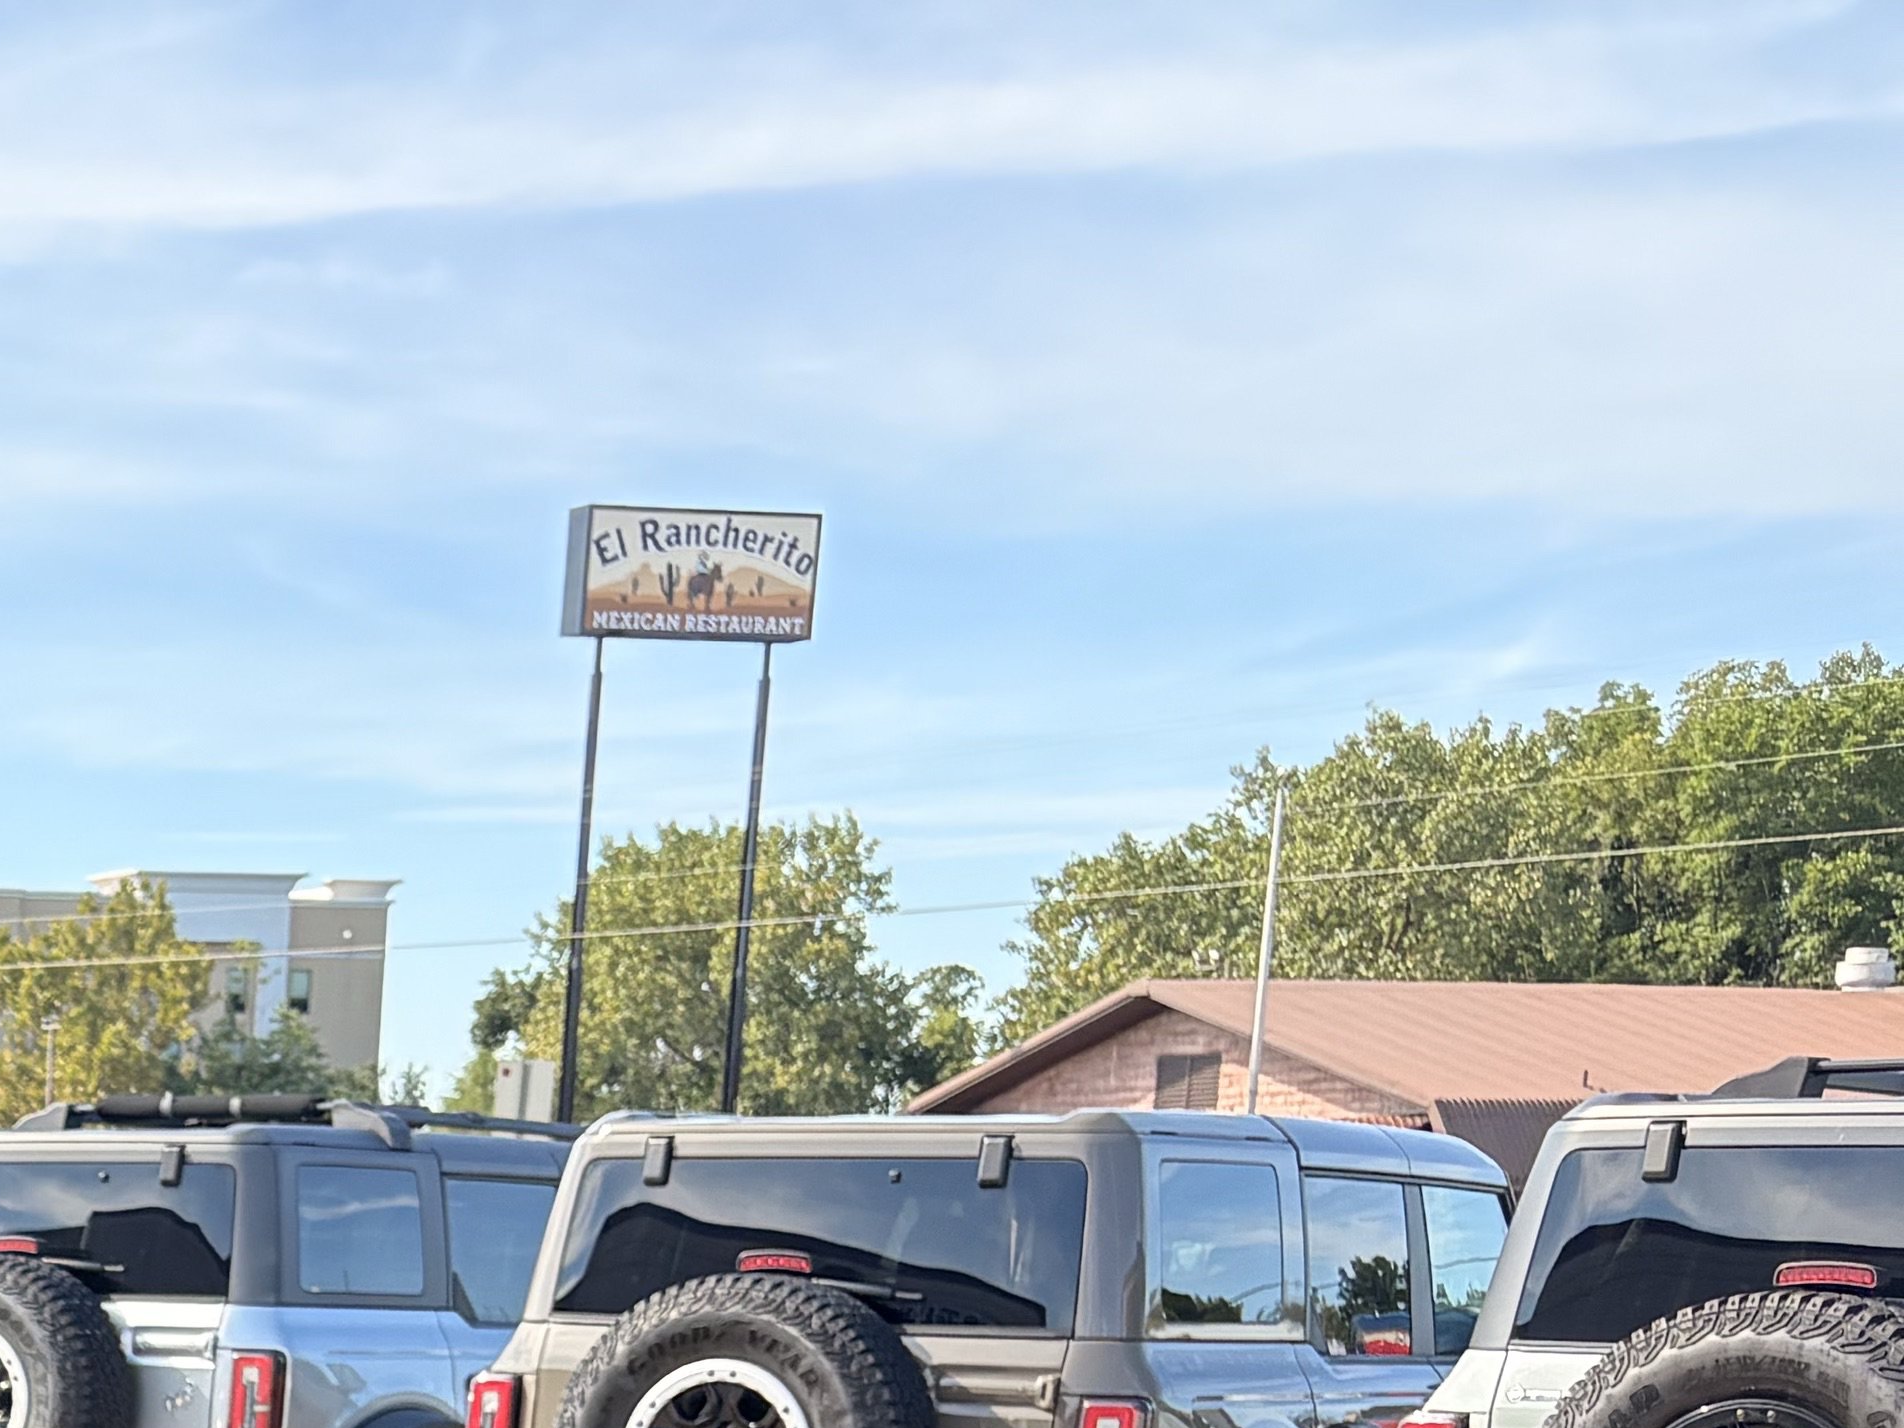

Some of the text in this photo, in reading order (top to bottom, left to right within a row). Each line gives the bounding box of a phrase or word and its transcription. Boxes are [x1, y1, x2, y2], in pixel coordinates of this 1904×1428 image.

[594, 516, 814, 577] El Rancherito
[592, 610, 806, 635] MEXICAN RESTAURANT
